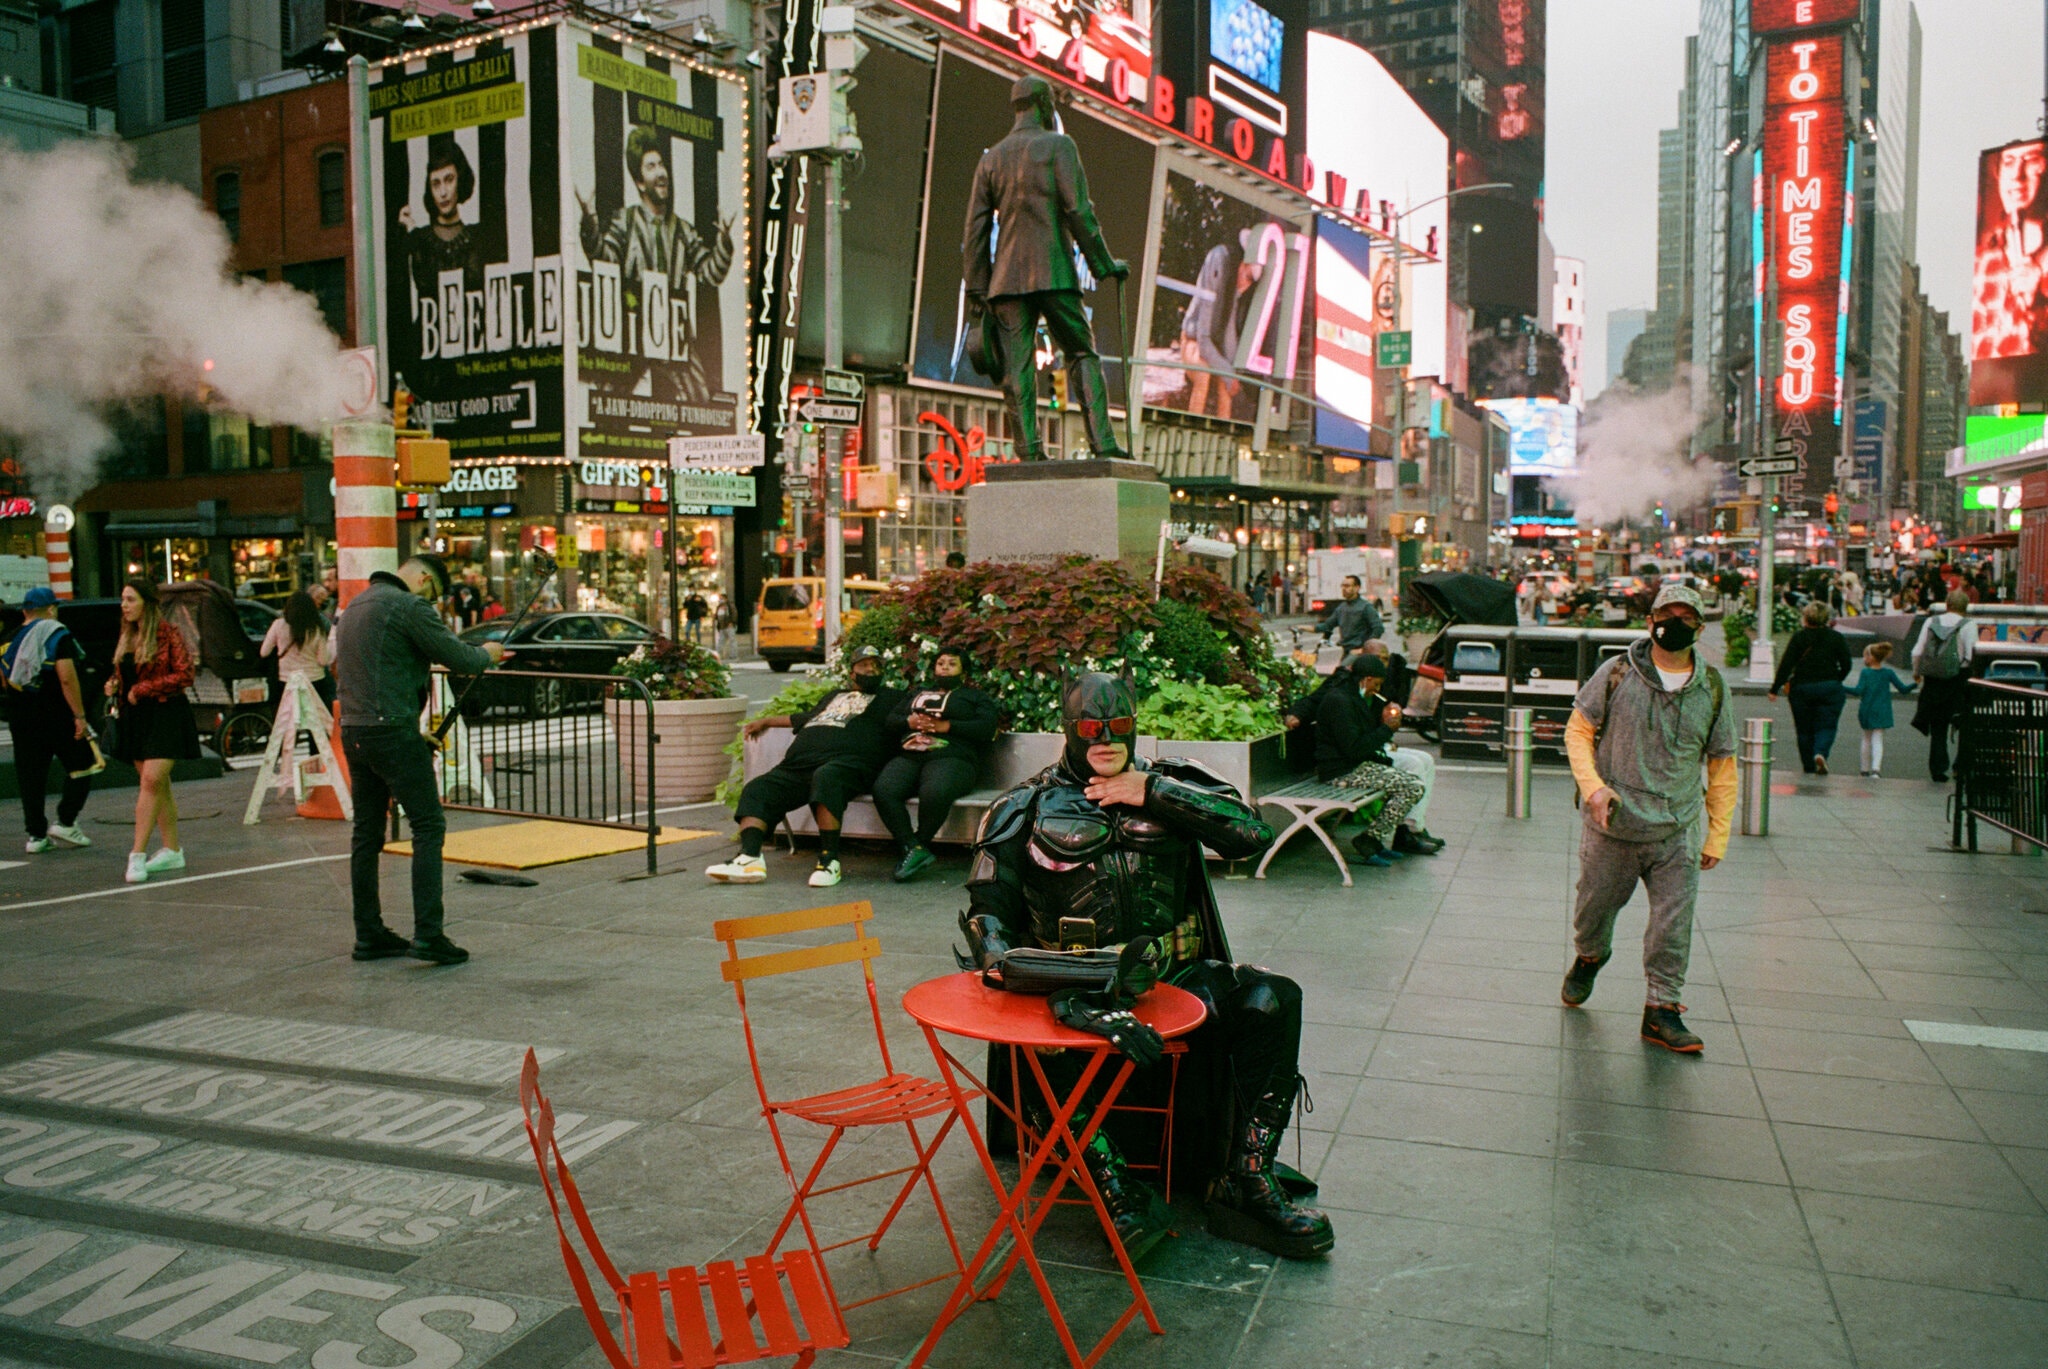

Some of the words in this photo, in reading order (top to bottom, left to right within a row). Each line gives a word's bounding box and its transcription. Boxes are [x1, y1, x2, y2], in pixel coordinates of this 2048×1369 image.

[369, 84, 399, 111] TIMES
[401, 73, 442, 104] SQUARE
[444, 65, 468, 91] CAN
[468, 53, 512, 85] REALLY
[1789, 42, 1818, 99] TO
[395, 109, 426, 135] MAKE
[430, 102, 450, 128] YOU
[454, 97, 481, 122] FEEL
[485, 89, 522, 115] ALIVE!
[638, 100, 654, 123] ON
[655, 104, 715, 141] BROADWAY!
[967, 0, 1130, 103] 1540
[1153, 75, 1396, 233] BROADWAY
[1783, 111, 1821, 278] TIMES
[759, 220, 780, 324] MAC
[785, 223, 804, 327] MAC
[1245, 222, 1310, 380] 21
[460, 397, 489, 417] GOOD
[751, 334, 770, 435] MAC
[775, 337, 794, 439] MAC
[604, 398, 679, 423] JAW-DROPPING
[806, 405, 823, 417] ONE
[832, 407, 853, 419] WAY
[684, 440, 723, 451] PEDESTRIAN
[724, 439, 741, 449] FLOW
[743, 439, 760, 449] ZONE
[718, 452, 733, 462] KEEP
[735, 451, 760, 462] MOVING
[1772, 462, 1791, 472] WAY
[581, 462, 641, 488] GIFTS
[685, 478, 720, 488] PEDESTRIAN
[685, 490, 700, 500] KEEP
[701, 490, 723, 500] MOVING
[678, 504, 709, 515] SONY
[2, 1061, 643, 1166] AMSTERDAM
[142, 1149, 522, 1217] AMERICAN
[76, 1173, 462, 1246] AIRLINES
